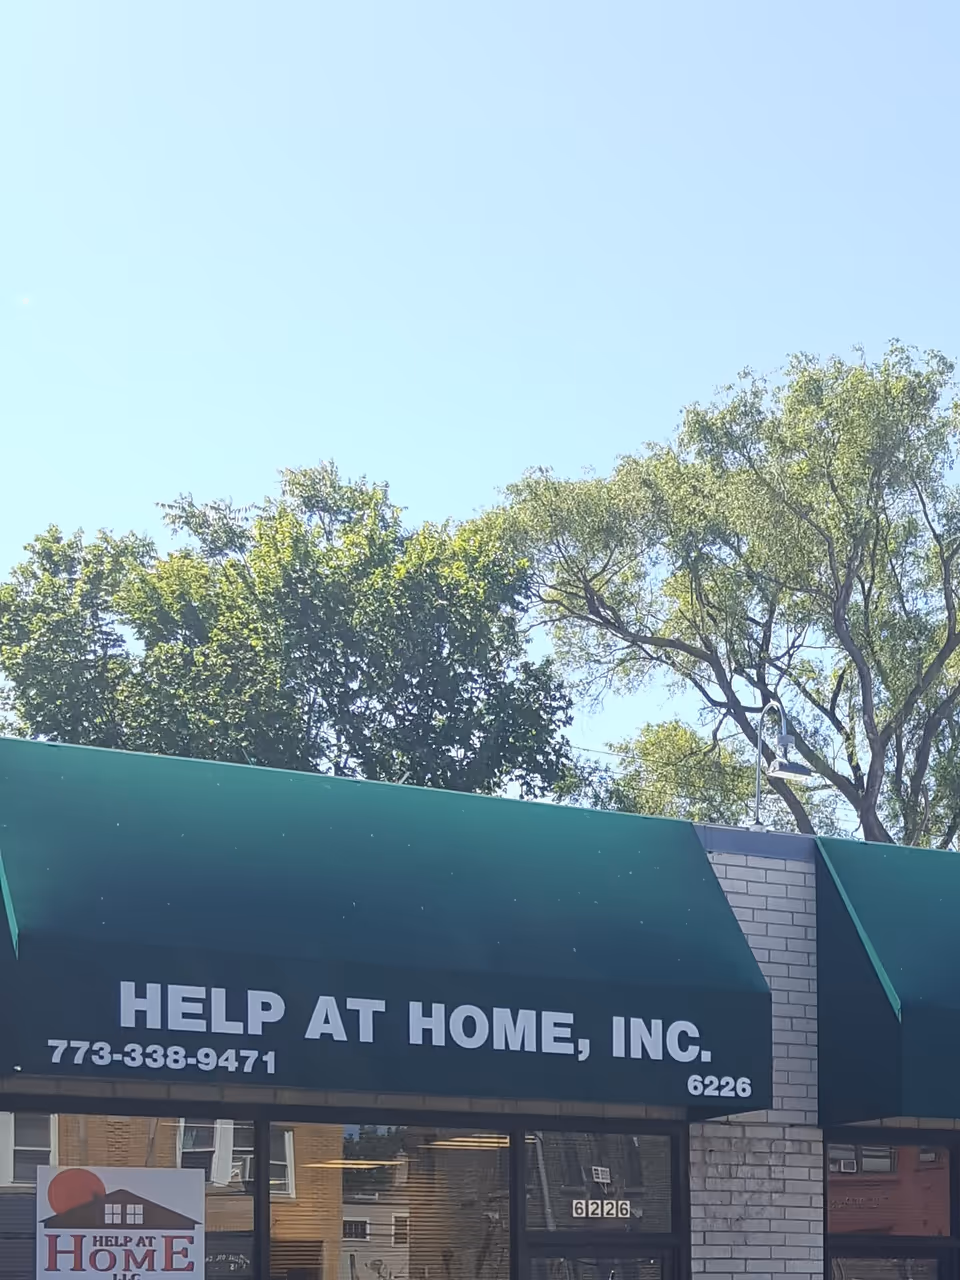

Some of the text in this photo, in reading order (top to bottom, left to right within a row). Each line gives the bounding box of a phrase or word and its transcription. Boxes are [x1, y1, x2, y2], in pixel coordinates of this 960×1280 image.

[120, 980, 712, 1063] HELP AT HOME, INC.
[47, 1039, 276, 1074] 773-338-9471
[687, 1074, 752, 1098] 6226
[574, 1201, 629, 1216] 6226
[43, 1233, 195, 1273] HOME
[92, 1235, 156, 1247] HELP AT
